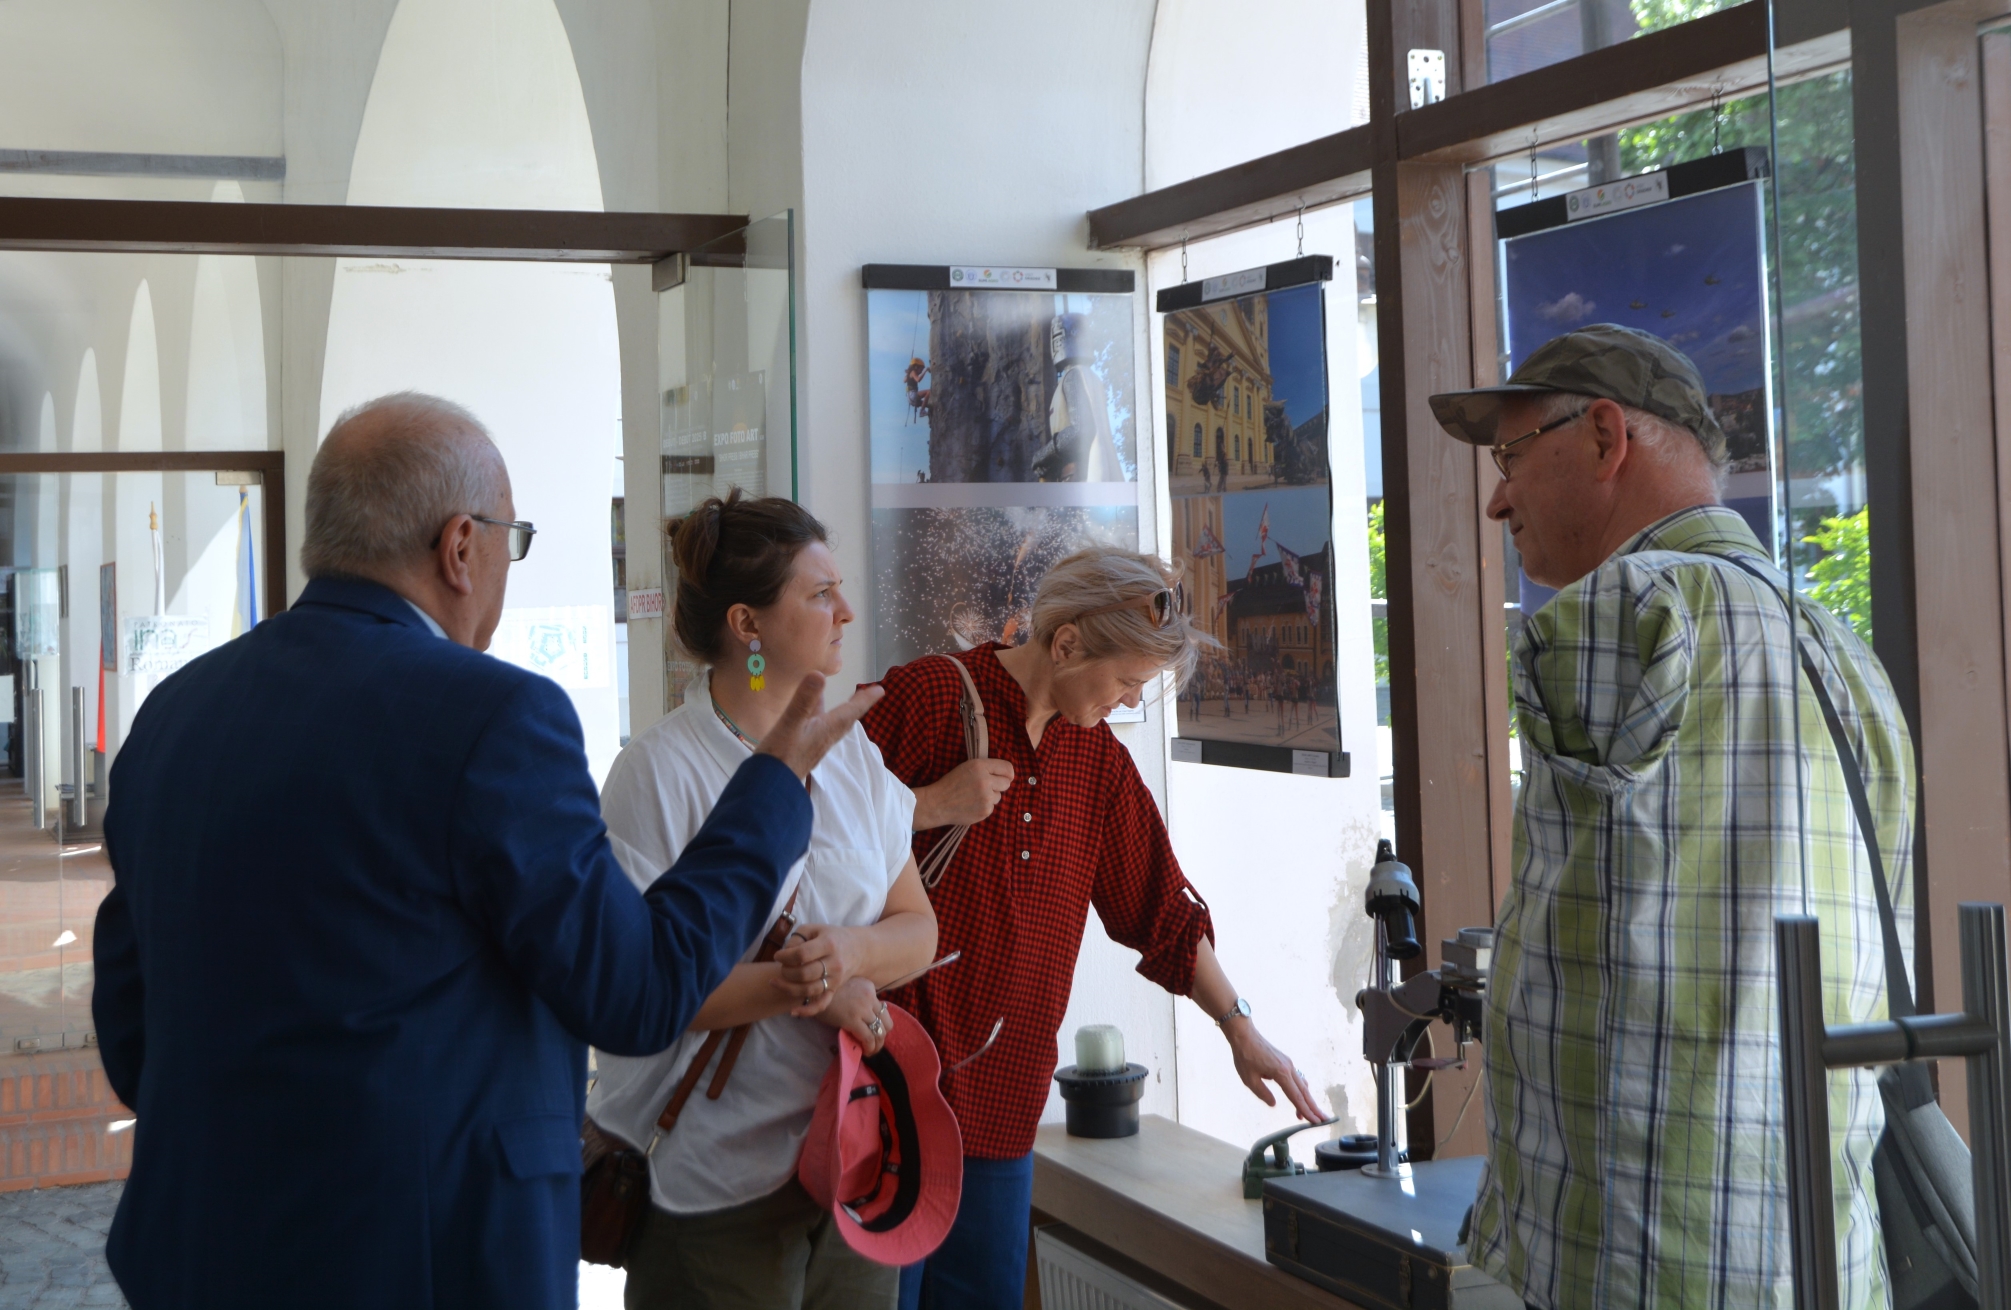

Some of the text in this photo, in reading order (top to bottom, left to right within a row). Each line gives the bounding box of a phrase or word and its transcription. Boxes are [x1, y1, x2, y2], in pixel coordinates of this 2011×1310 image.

[714, 428, 758, 446] EXPO FOTO ART
[130, 657, 188, 672] Roman
